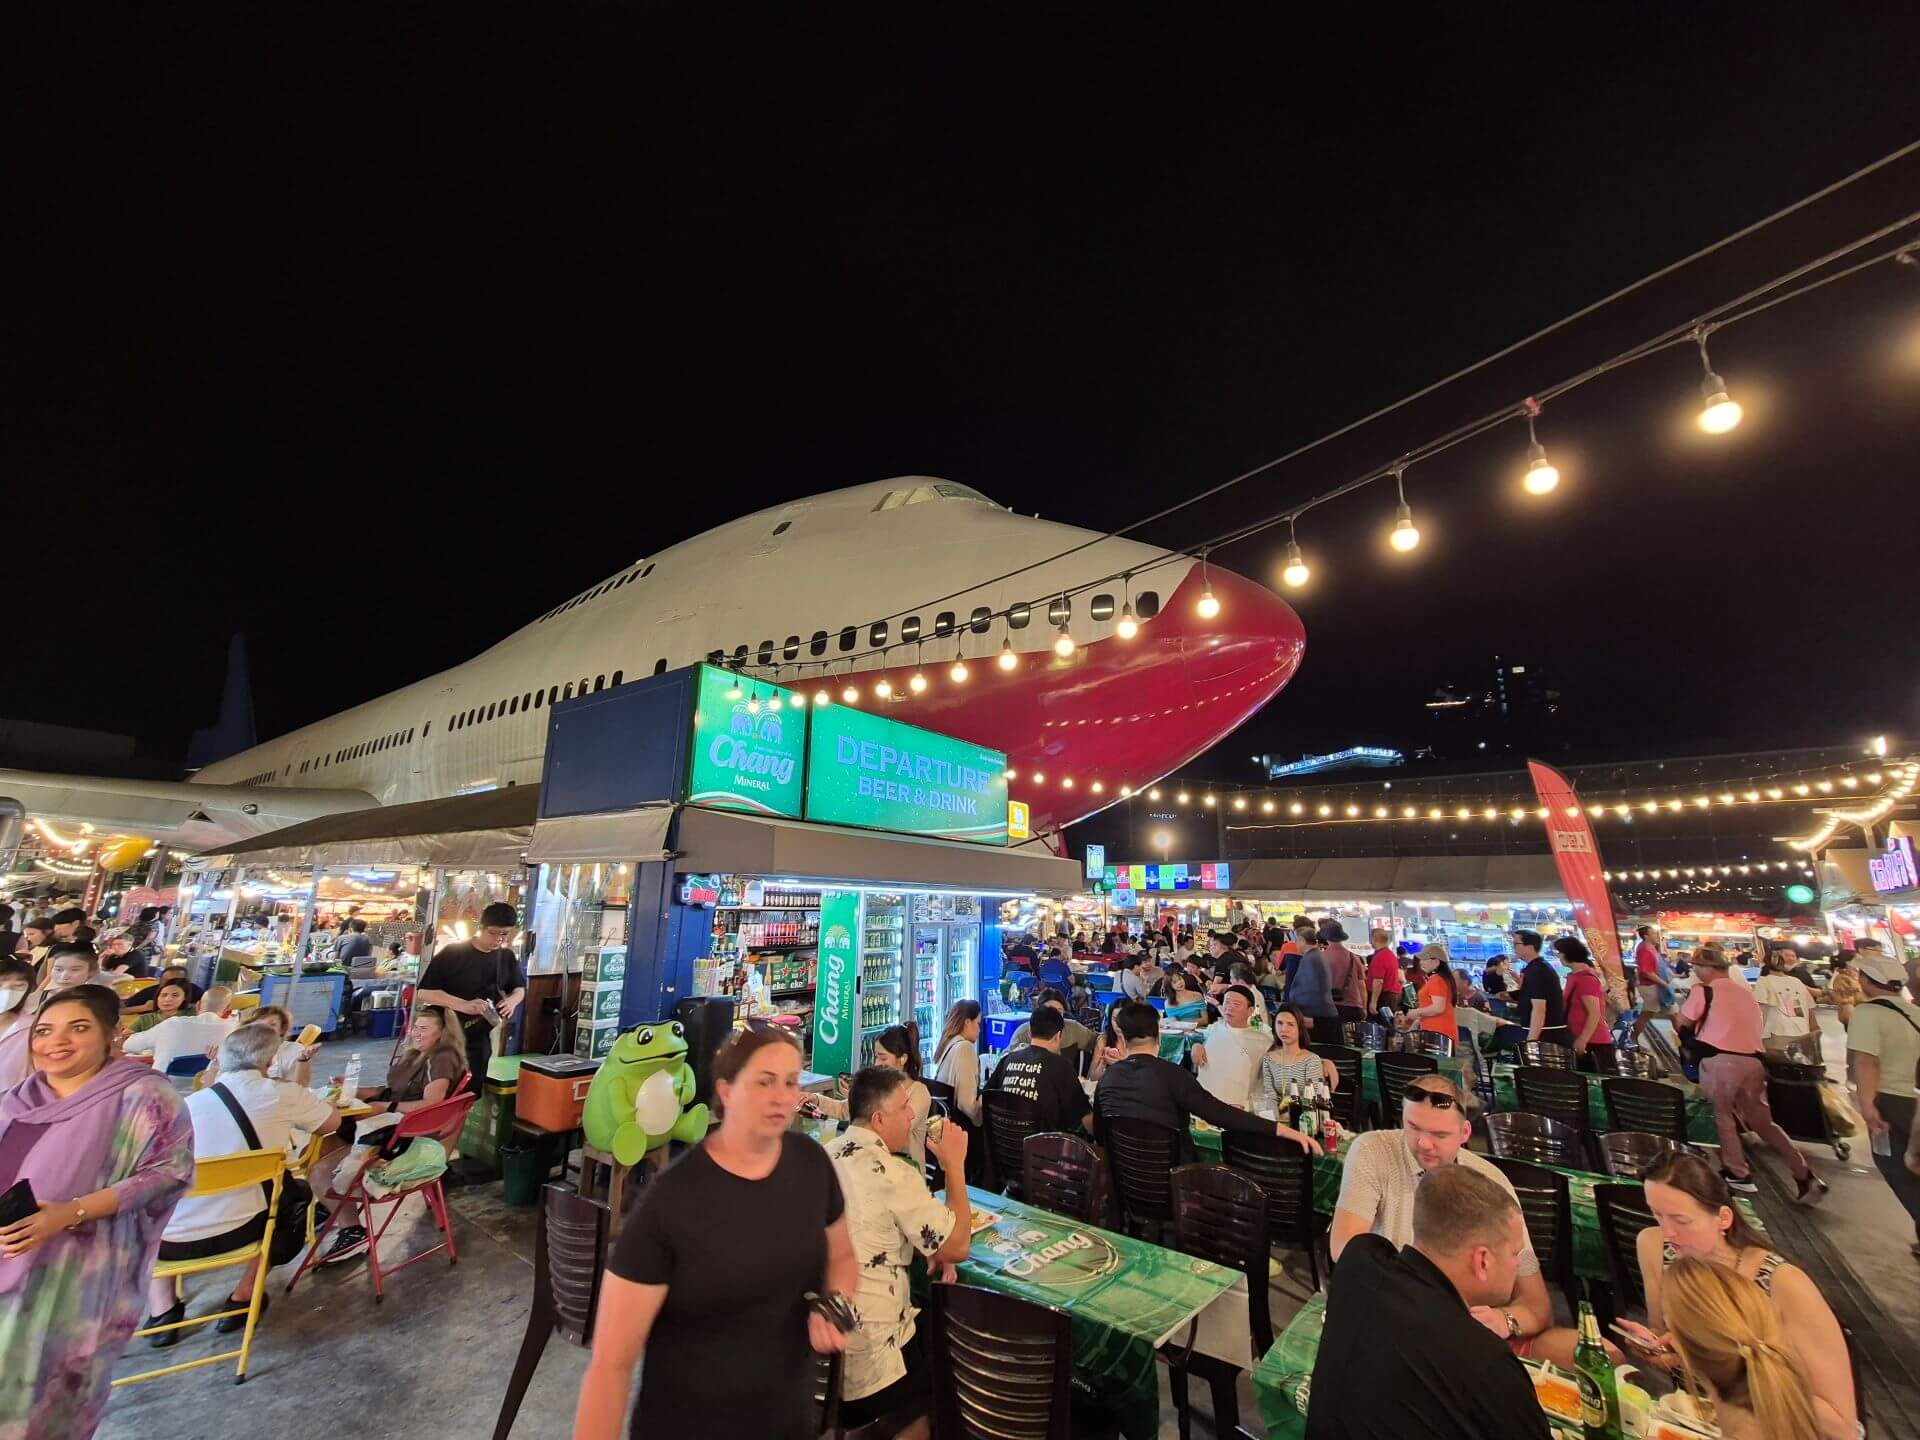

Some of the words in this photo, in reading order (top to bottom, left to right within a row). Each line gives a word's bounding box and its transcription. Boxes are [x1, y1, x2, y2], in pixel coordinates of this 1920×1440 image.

[709, 735, 794, 784] Chang
[836, 735, 992, 796] DEPARTURE
[734, 775, 770, 791] MINERAL
[858, 775, 909, 803] BEER
[914, 787, 926, 805] &
[929, 790, 977, 816] DRINK
[819, 953, 845, 1045] Chang
[841, 979, 851, 1020] MINERAL
[1004, 1231, 1094, 1275] Chang
